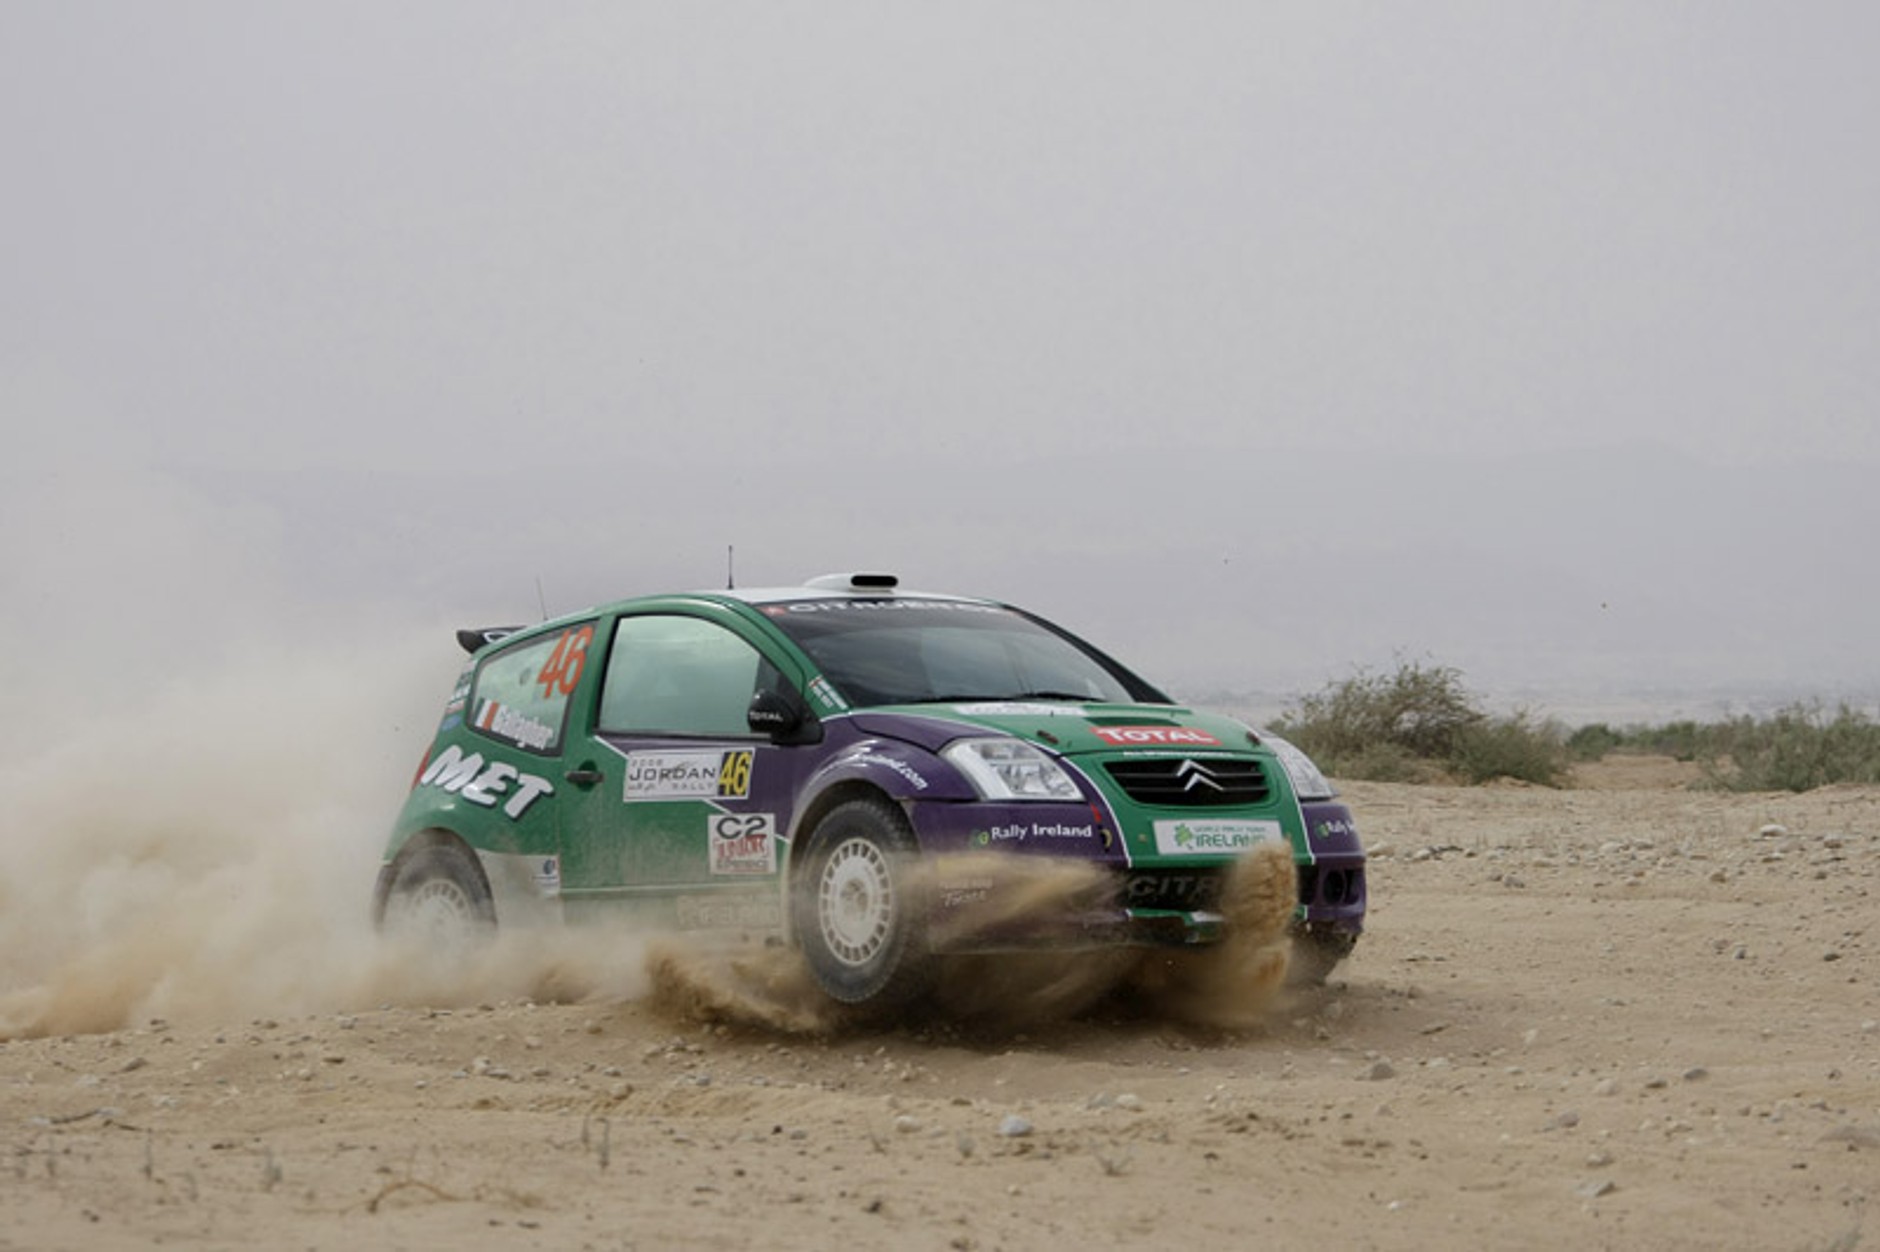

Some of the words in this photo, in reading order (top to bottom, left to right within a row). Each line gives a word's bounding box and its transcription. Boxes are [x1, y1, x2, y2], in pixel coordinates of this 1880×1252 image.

[536, 625, 593, 698] 46
[1098, 726, 1217, 744] TOTAL
[421, 744, 555, 819] MET
[629, 766, 717, 783] JORDAN
[717, 751, 753, 797] 46
[715, 815, 767, 840] C2
[991, 824, 1029, 841] Rally
[1031, 822, 1093, 838] Ireland
